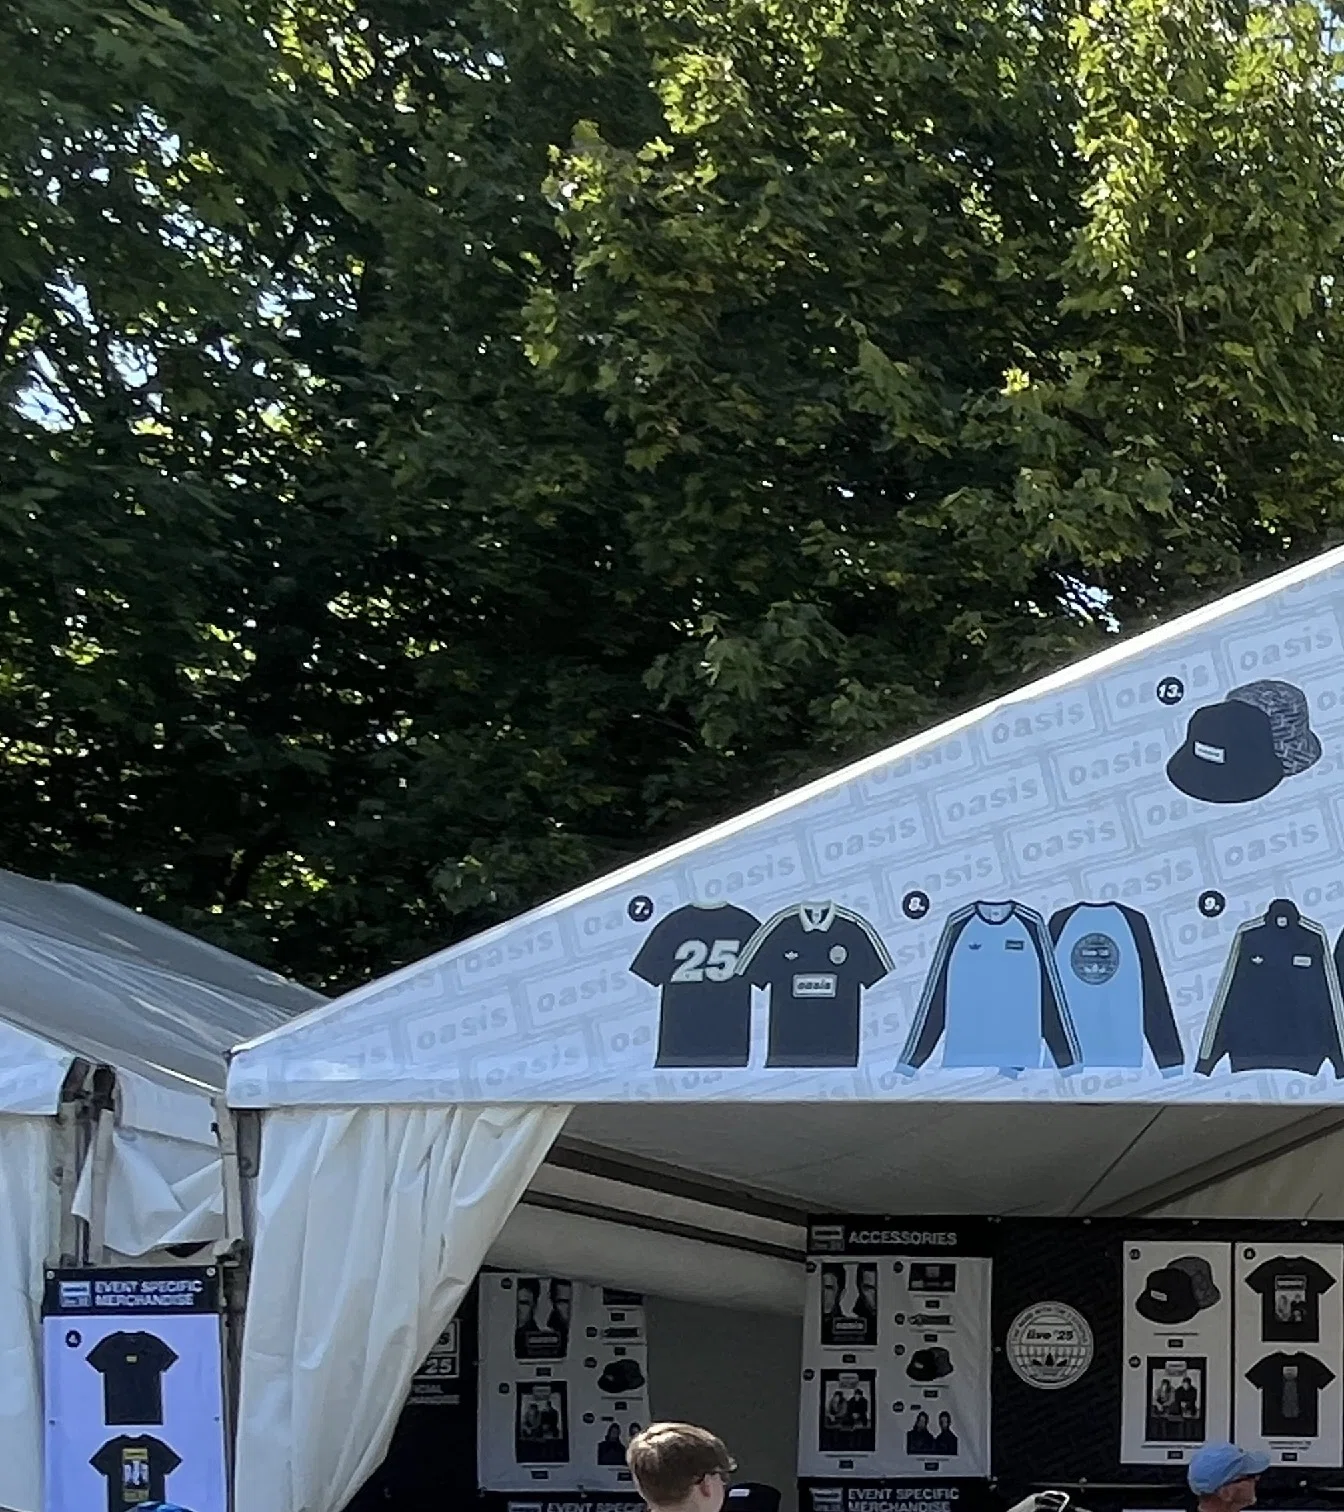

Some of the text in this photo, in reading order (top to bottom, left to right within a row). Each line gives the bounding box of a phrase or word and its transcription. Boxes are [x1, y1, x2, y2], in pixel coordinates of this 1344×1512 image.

[1240, 620, 1334, 671] oasis
[1156, 682, 1183, 700] 13.
[991, 696, 1085, 745] oasis
[1068, 738, 1163, 788] oasis
[948, 774, 1040, 822] oasis
[824, 807, 918, 862] oasis
[1022, 806, 1117, 862] oasis
[1224, 819, 1319, 867] oasis
[704, 850, 798, 899] oasis
[634, 901, 651, 917] 7.
[464, 930, 555, 973] oasis
[670, 939, 741, 983] 25
[537, 958, 628, 1013] oasis
[417, 997, 508, 1051] oasis
[848, 1230, 958, 1246] ACCESSORIES
[94, 1280, 203, 1293] EVENT SPECIFIC
[94, 1293, 195, 1306] MERCHANDISE
[848, 1488, 893, 1500] EVENT
[897, 1488, 959, 1501] SPECIFIC
